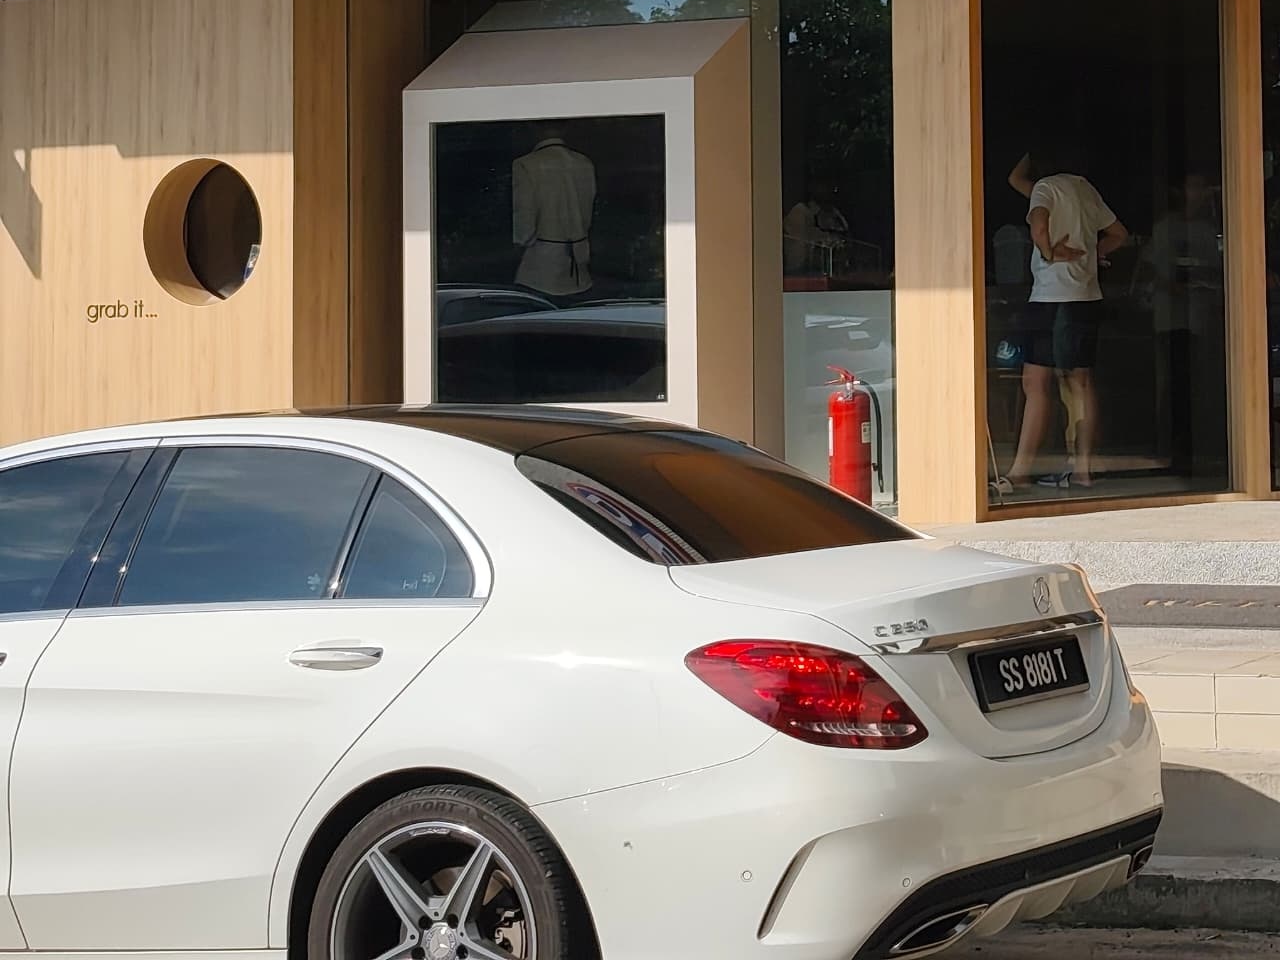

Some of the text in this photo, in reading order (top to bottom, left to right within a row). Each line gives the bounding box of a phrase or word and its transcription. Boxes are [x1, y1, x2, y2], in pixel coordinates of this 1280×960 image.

[87, 299, 129, 323] grab
[874, 625, 889, 637] C
[1000, 647, 1068, 693] SS 8181 T
